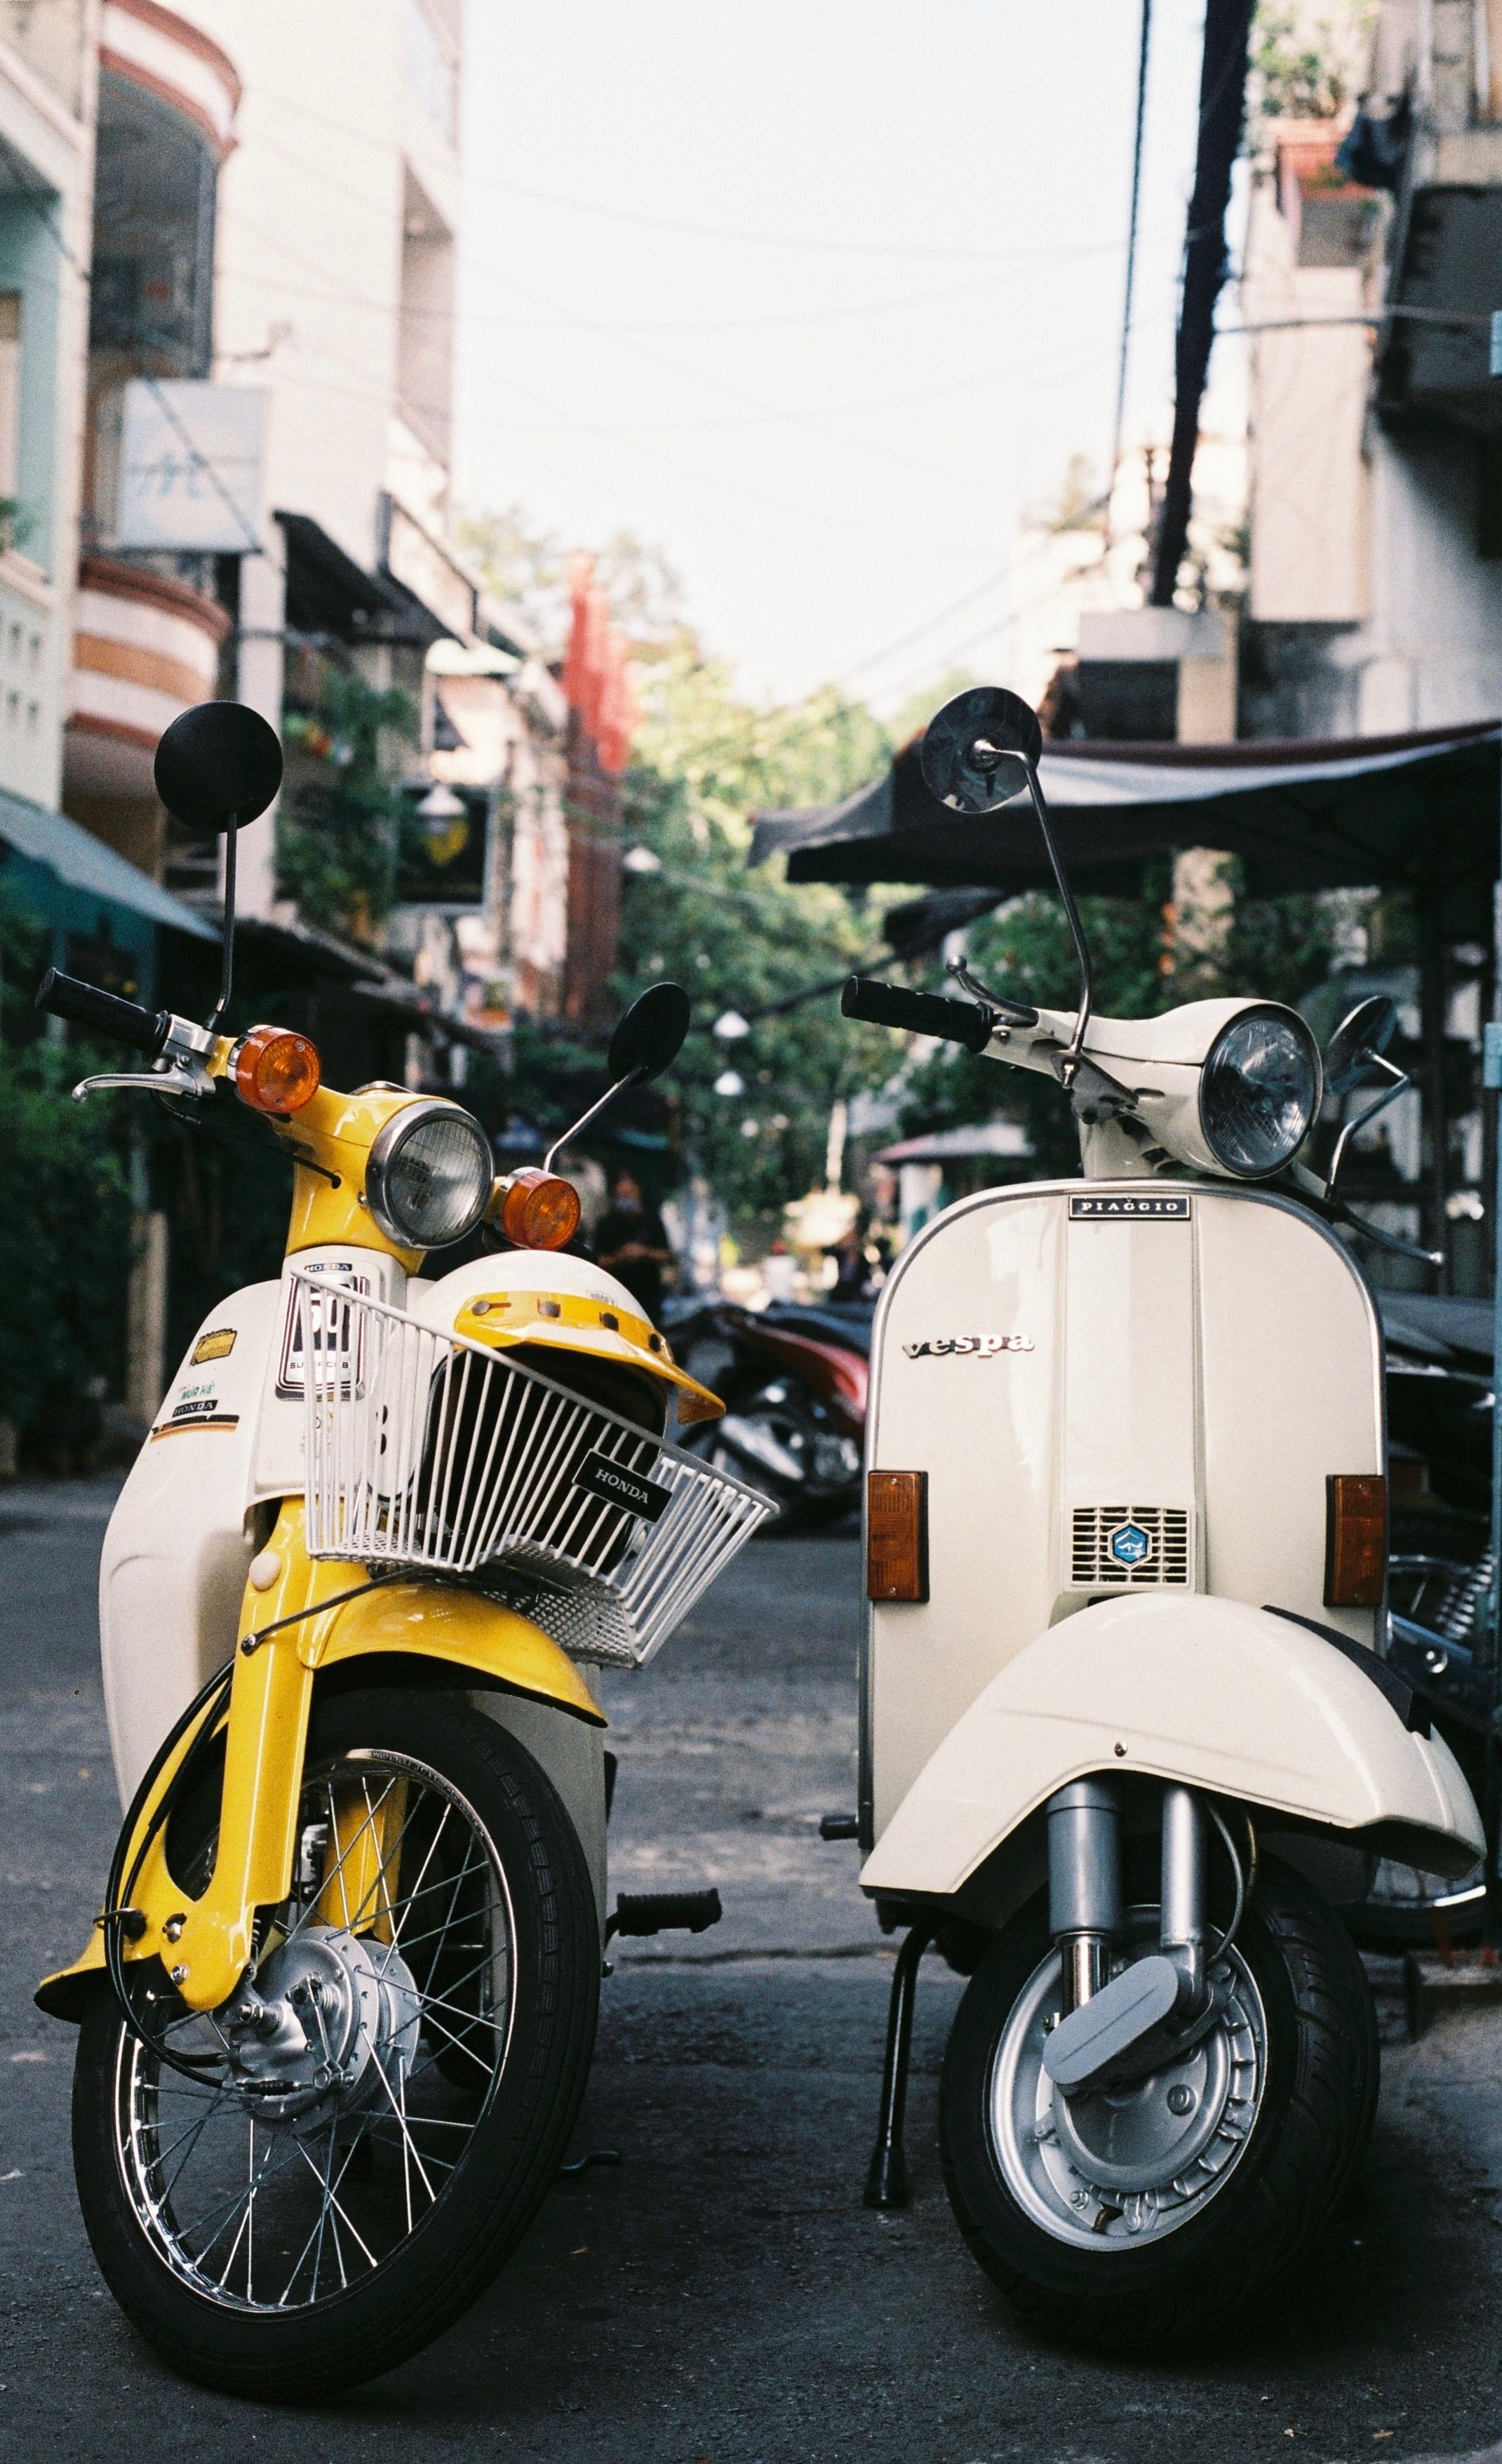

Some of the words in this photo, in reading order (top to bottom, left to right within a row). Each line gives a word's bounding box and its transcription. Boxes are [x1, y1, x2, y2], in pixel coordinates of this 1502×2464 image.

[1081, 1202, 1179, 1211] PIAGGIO
[902, 1332, 1035, 1359] vespa
[175, 1402, 213, 1414] HONDA
[594, 1468, 649, 1504] HONDA
